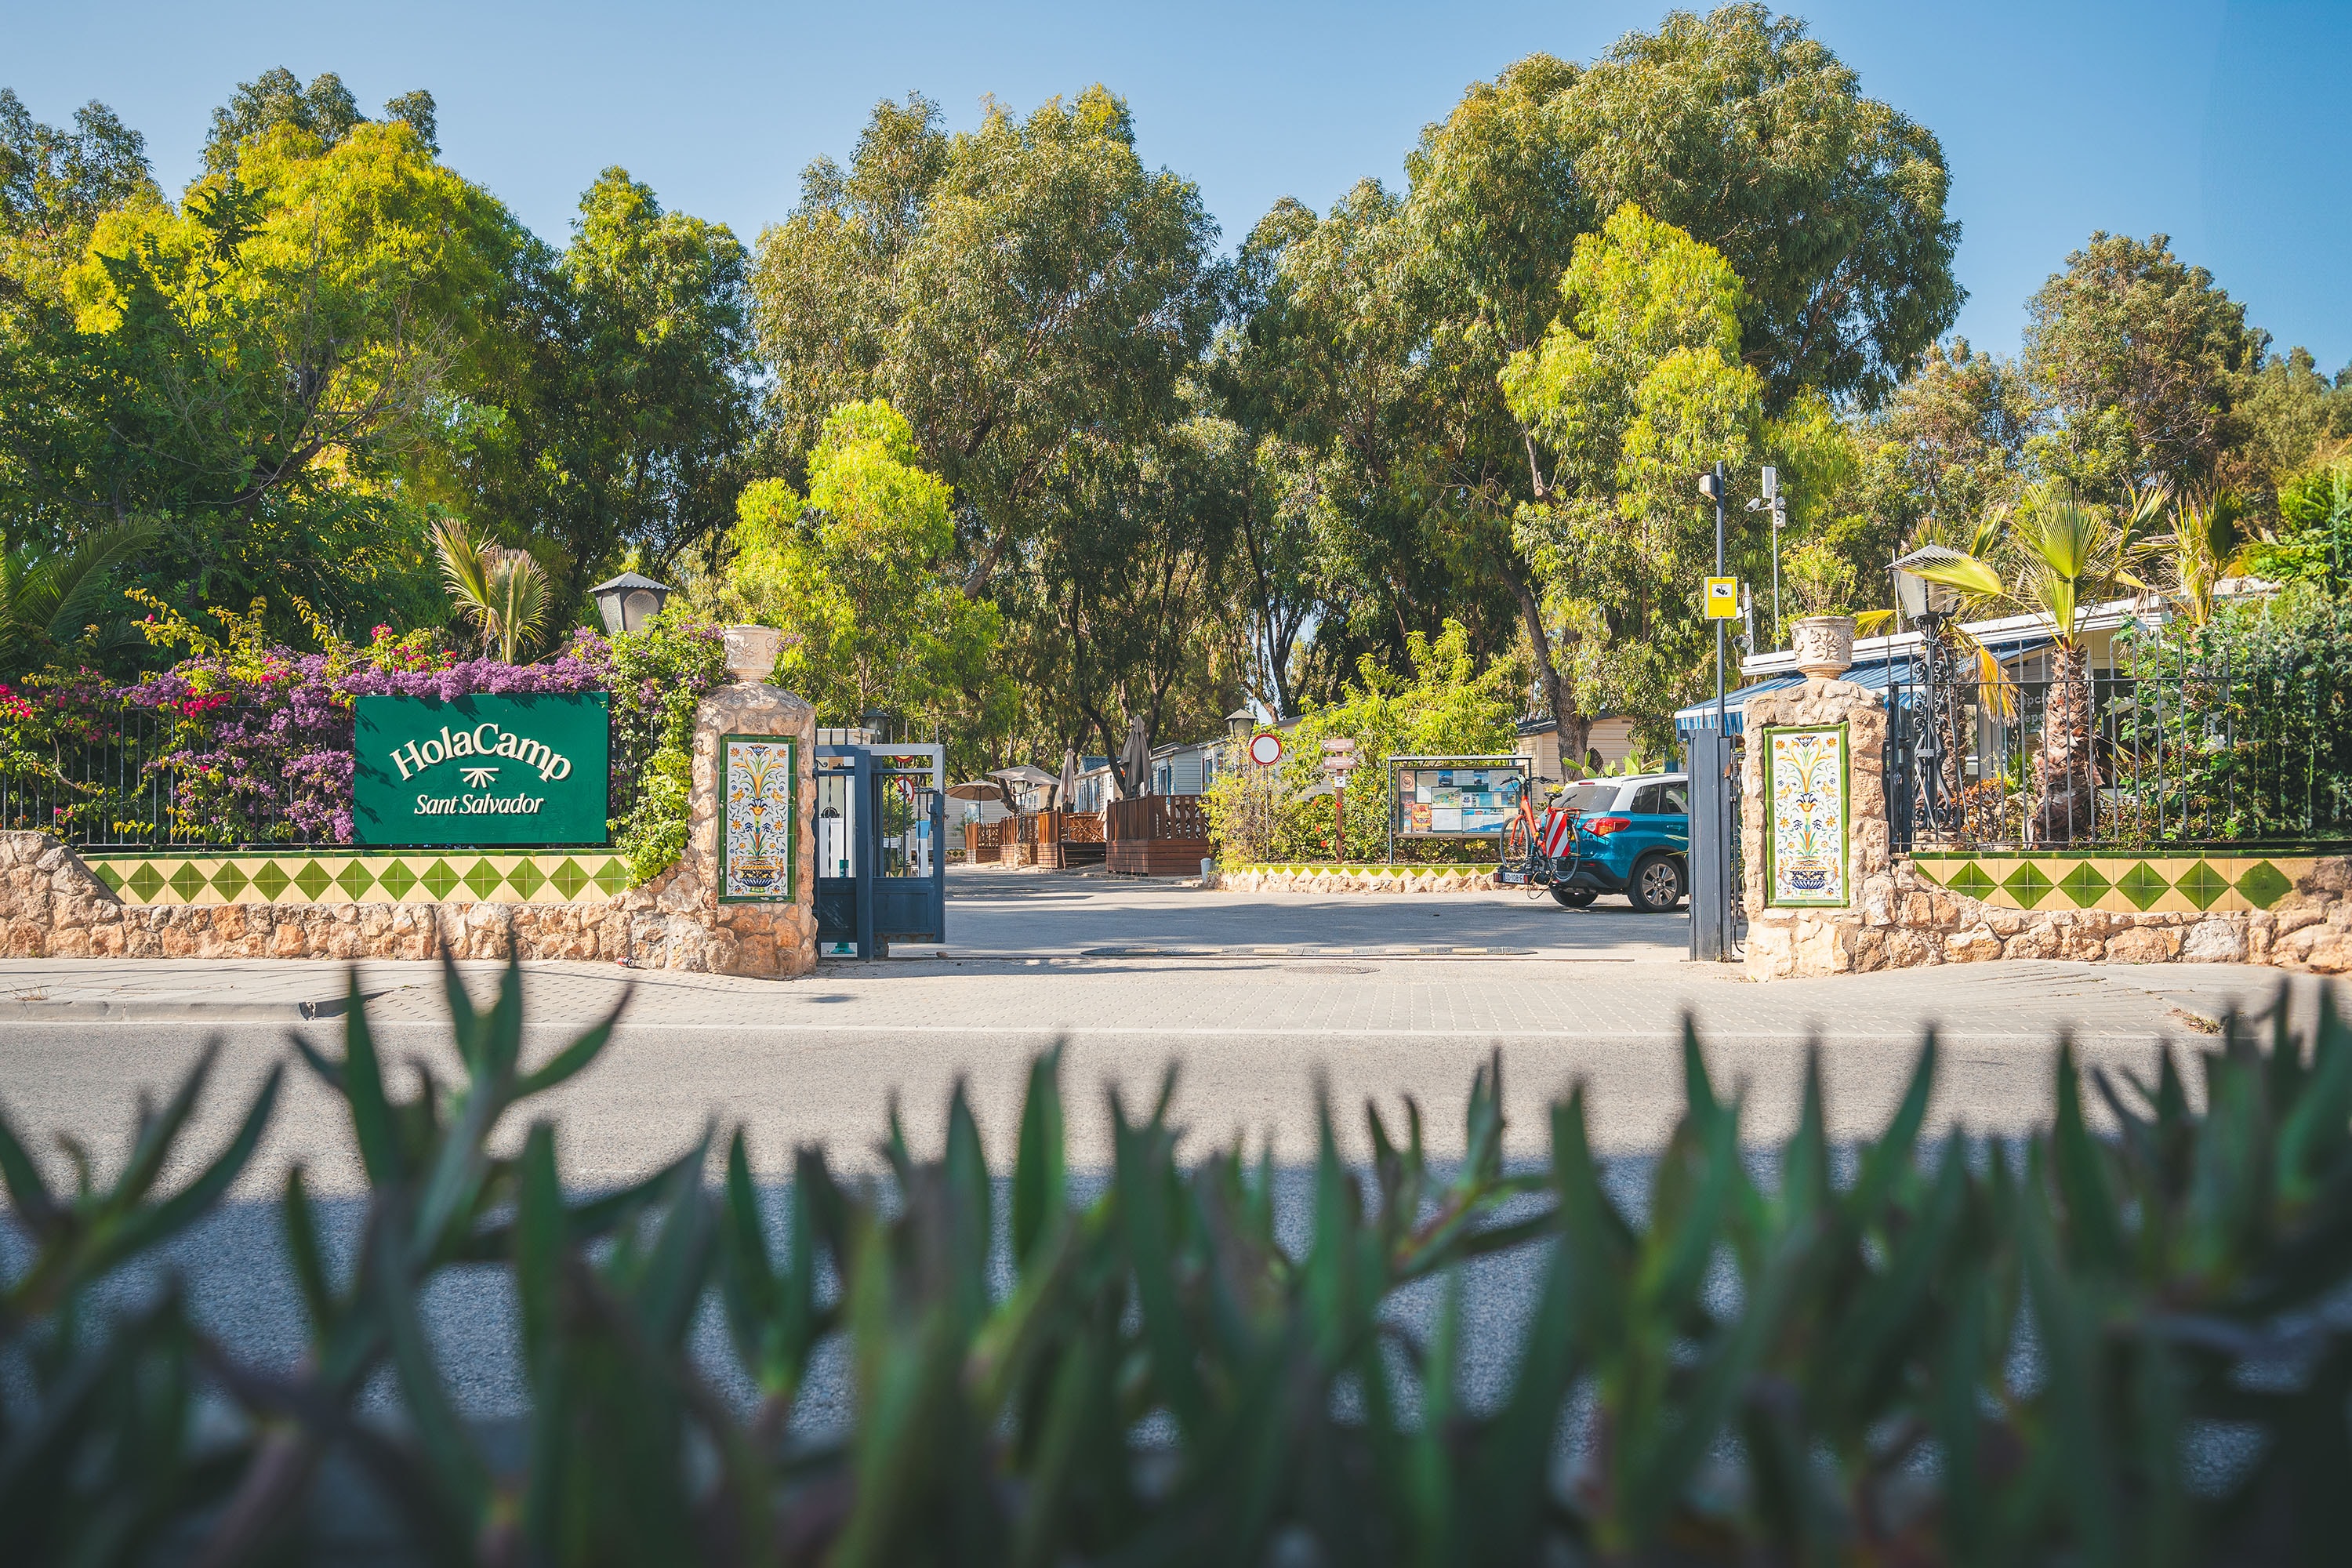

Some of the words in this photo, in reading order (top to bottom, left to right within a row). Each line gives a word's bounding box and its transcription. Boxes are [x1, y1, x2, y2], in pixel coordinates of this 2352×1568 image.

[390, 723, 572, 782] HolaCamp
[414, 793, 459, 815] Sant
[459, 792, 544, 815] Salvador
